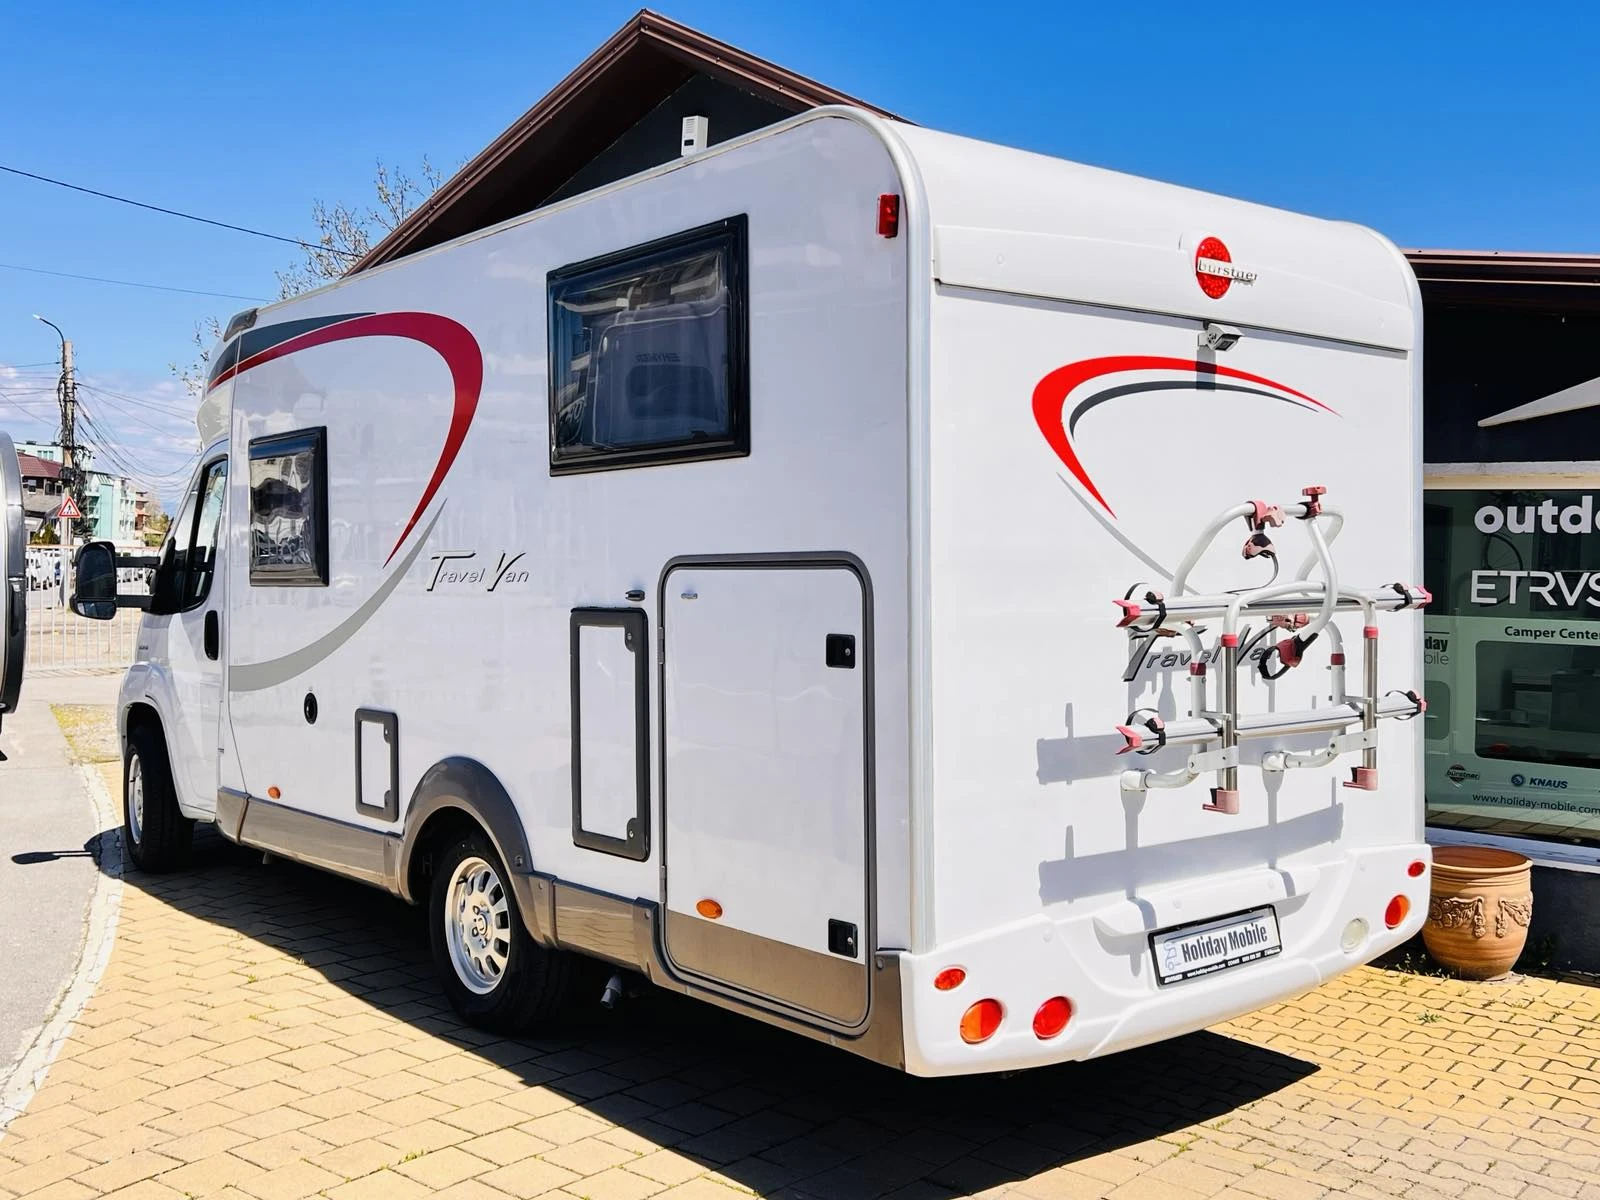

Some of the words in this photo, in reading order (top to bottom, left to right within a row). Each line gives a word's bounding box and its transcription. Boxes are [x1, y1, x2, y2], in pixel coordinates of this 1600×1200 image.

[1474, 496, 1600, 534] outd
[427, 552, 486, 592] Travel
[487, 552, 529, 592] Van
[1504, 625, 1556, 640] Camper
[1529, 777, 1568, 789] KNAUS
[1472, 792, 1600, 815] www.holiday-mobile.com
[1181, 936, 1228, 963] Holiday
[1228, 922, 1268, 950] Mobile
